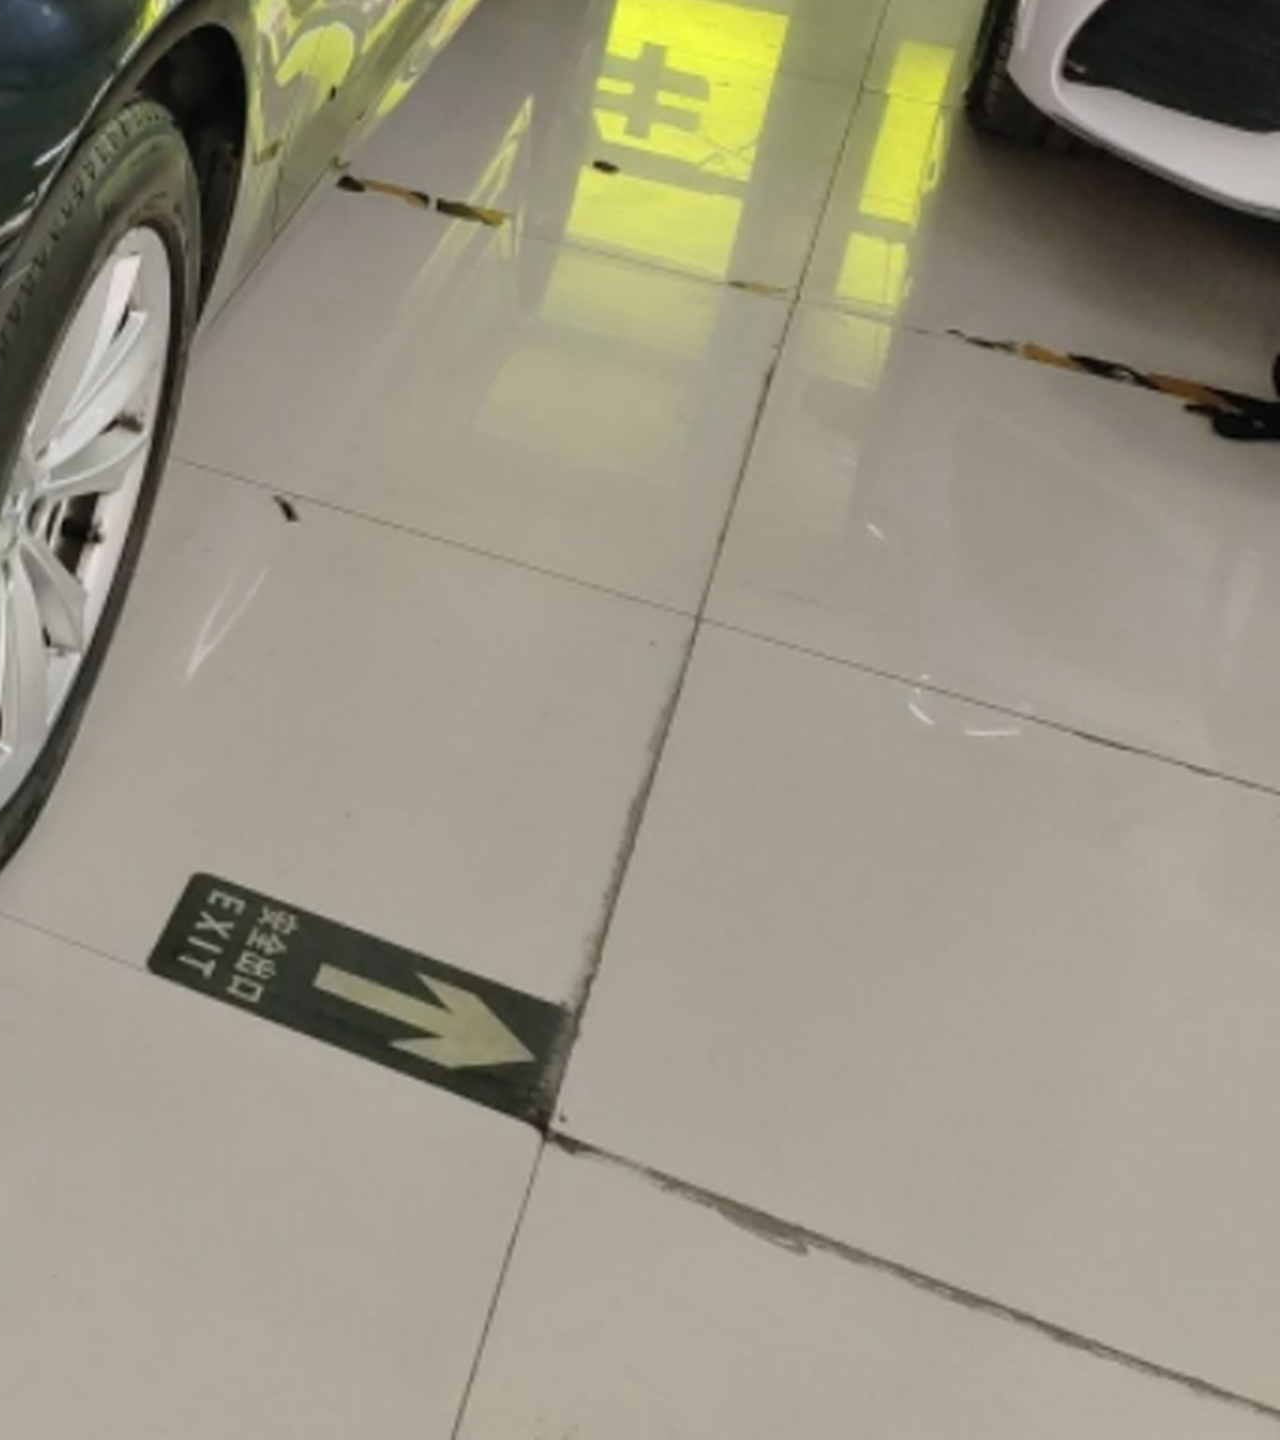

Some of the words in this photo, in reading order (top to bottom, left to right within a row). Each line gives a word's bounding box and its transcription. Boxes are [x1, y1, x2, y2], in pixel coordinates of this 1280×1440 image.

[177, 889, 247, 979] EXIT
[225, 904, 298, 1003] 安全出口
